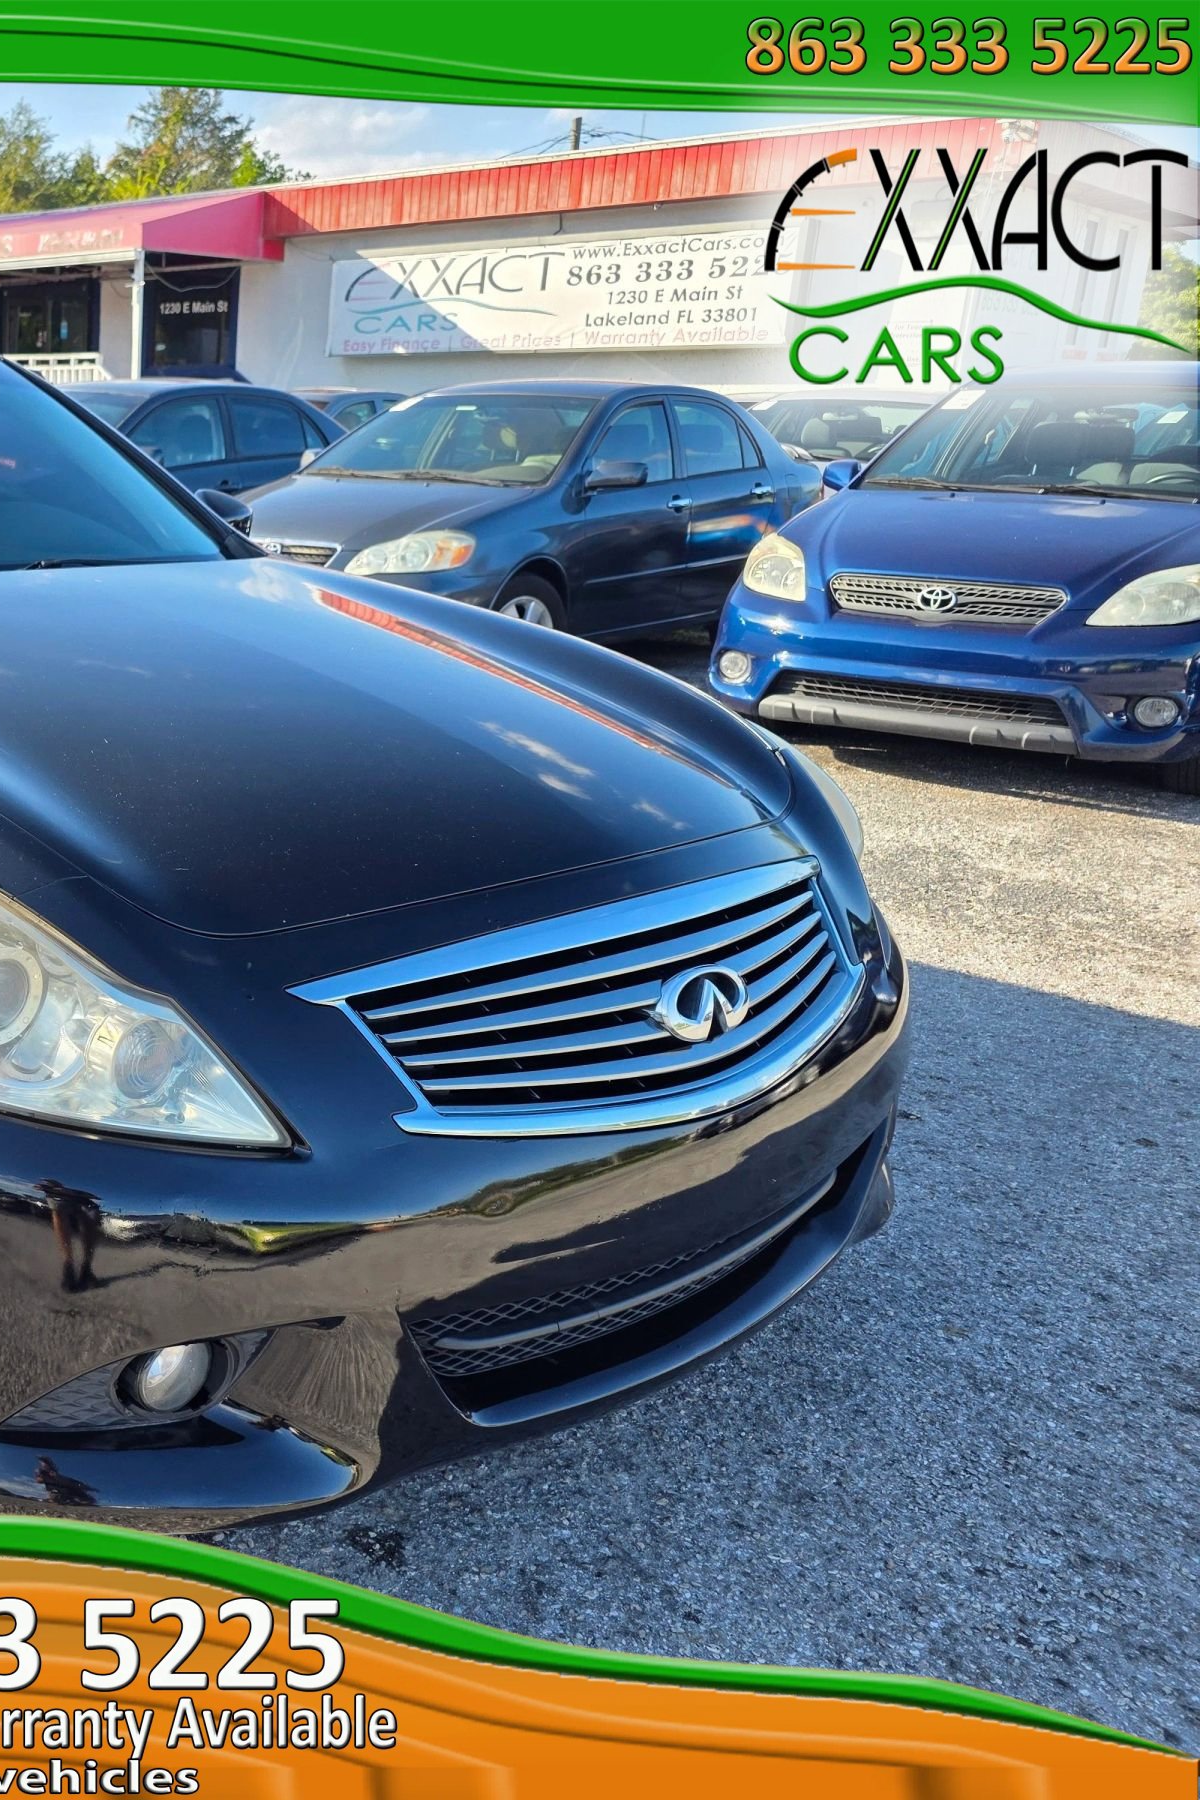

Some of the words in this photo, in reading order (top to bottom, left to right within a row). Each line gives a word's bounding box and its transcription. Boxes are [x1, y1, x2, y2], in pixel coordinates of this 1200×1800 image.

[345, 252, 565, 302] EXXACT
[566, 264, 622, 287] 863
[635, 258, 694, 283] 333
[607, 289, 648, 305] 1230
[655, 289, 665, 303] E
[670, 286, 718, 302] Main
[726, 285, 743, 300] St
[160, 302, 180, 315] 1230
[183, 302, 190, 314] E
[191, 302, 215, 314] Main
[216, 300, 228, 313] St
[585, 310, 670, 327] Lakeland
[677, 310, 694, 324] FL
[701, 307, 757, 323] 33801
[354, 313, 458, 334] CARS
[343, 338, 376, 354] Easy
[380, 336, 440, 352] Finance
[460, 333, 506, 348] Great
[512, 333, 561, 348] Prices
[585, 329, 666, 346] Warranty
[672, 326, 768, 343] Available
